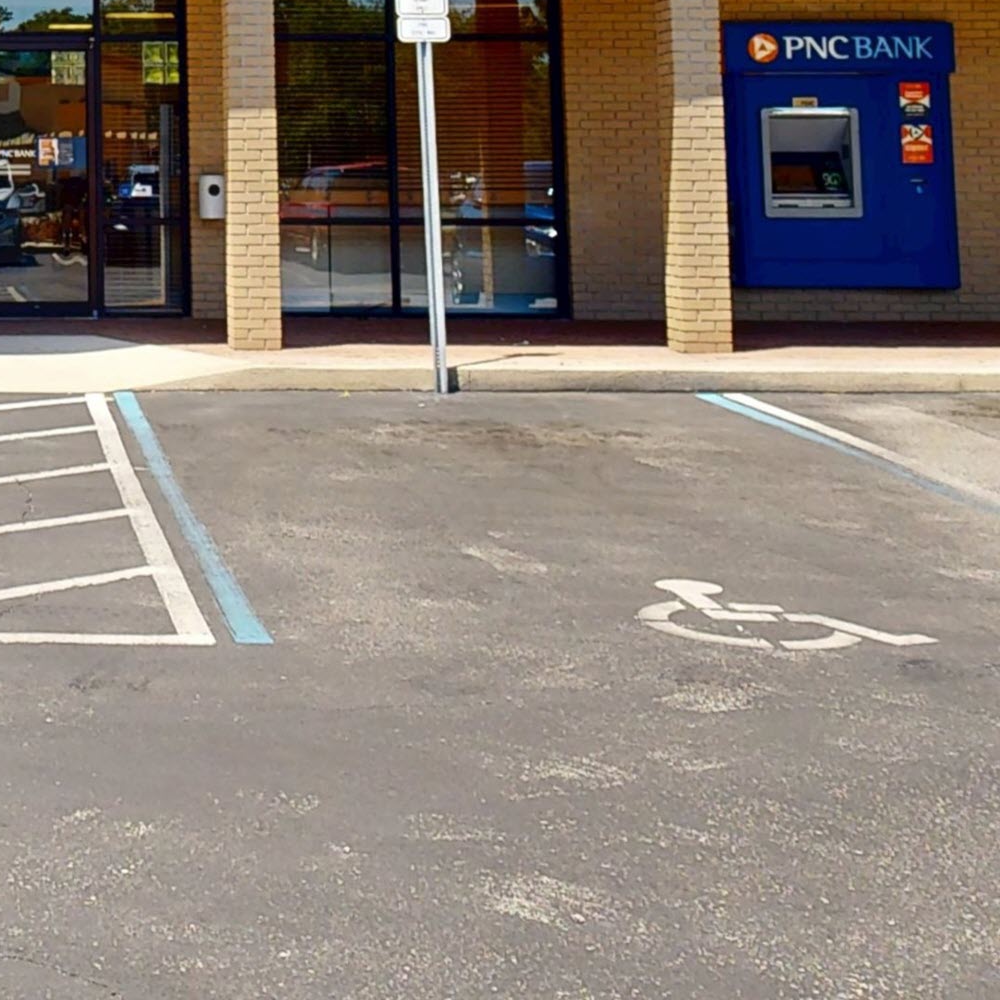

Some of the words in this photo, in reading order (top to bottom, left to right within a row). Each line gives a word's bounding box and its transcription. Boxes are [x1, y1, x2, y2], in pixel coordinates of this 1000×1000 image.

[782, 35, 849, 60] PNC
[851, 35, 933, 60] BANK
[14, 149, 36, 158] BANK
